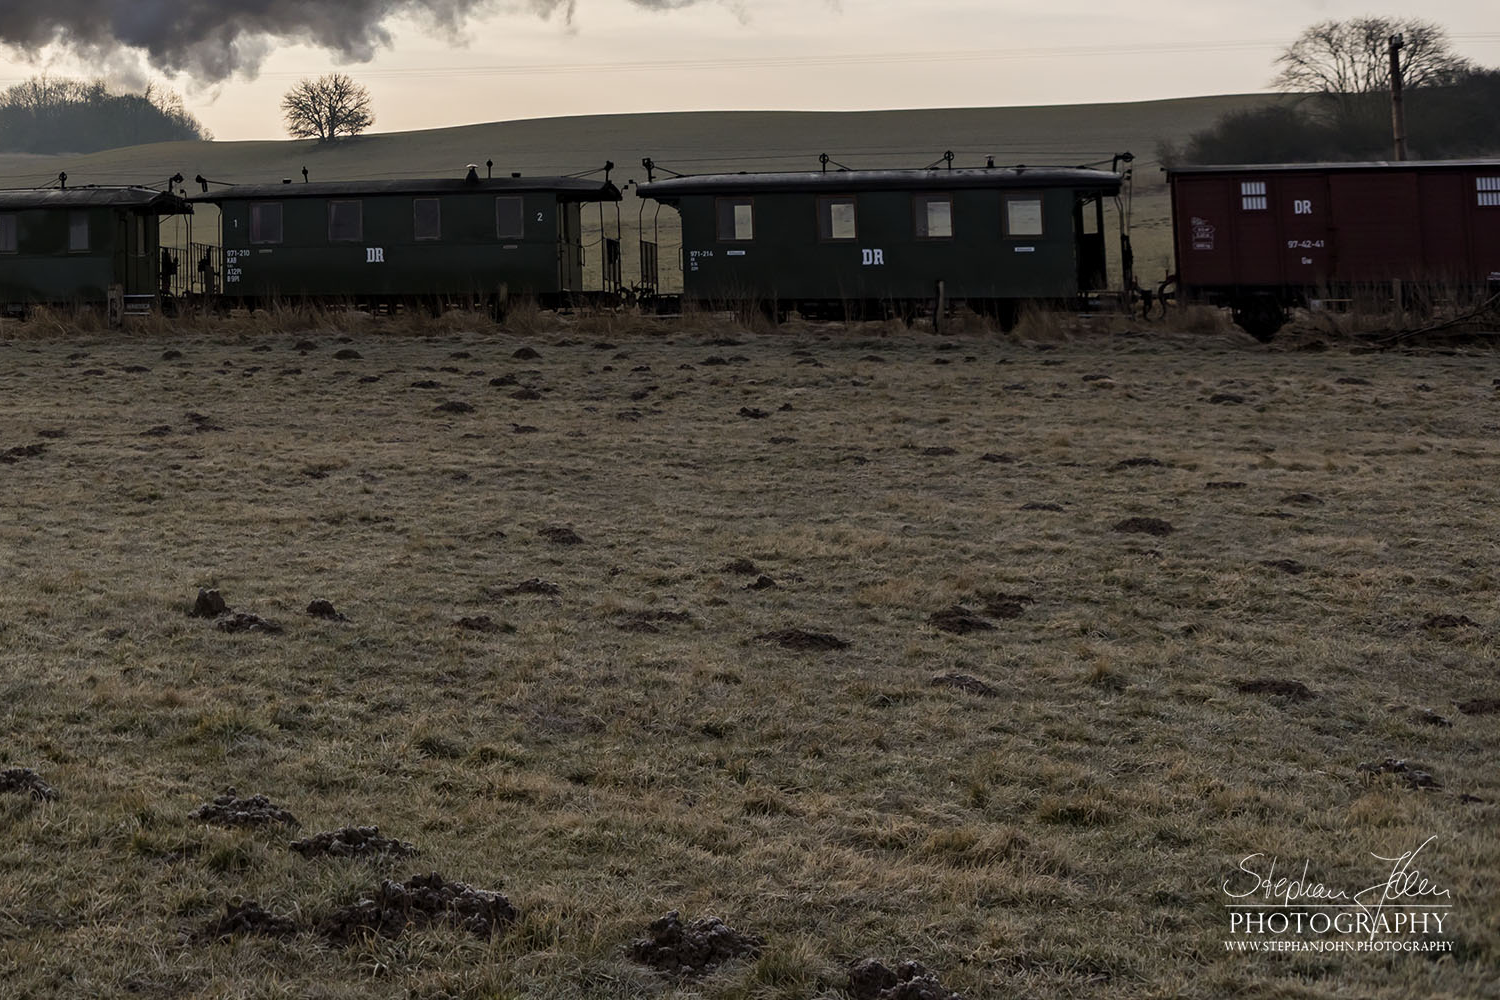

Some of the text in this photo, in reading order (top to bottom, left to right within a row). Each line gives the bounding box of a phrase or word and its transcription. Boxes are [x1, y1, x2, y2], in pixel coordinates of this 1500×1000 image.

[1294, 200, 1312, 215] DR
[537, 212, 543, 222] 2
[233, 219, 238, 228] 1
[1287, 240, 1325, 249] 97-42-41
[226, 249, 251, 257] 971-210
[366, 247, 385, 263] DR
[861, 249, 885, 265] DR
